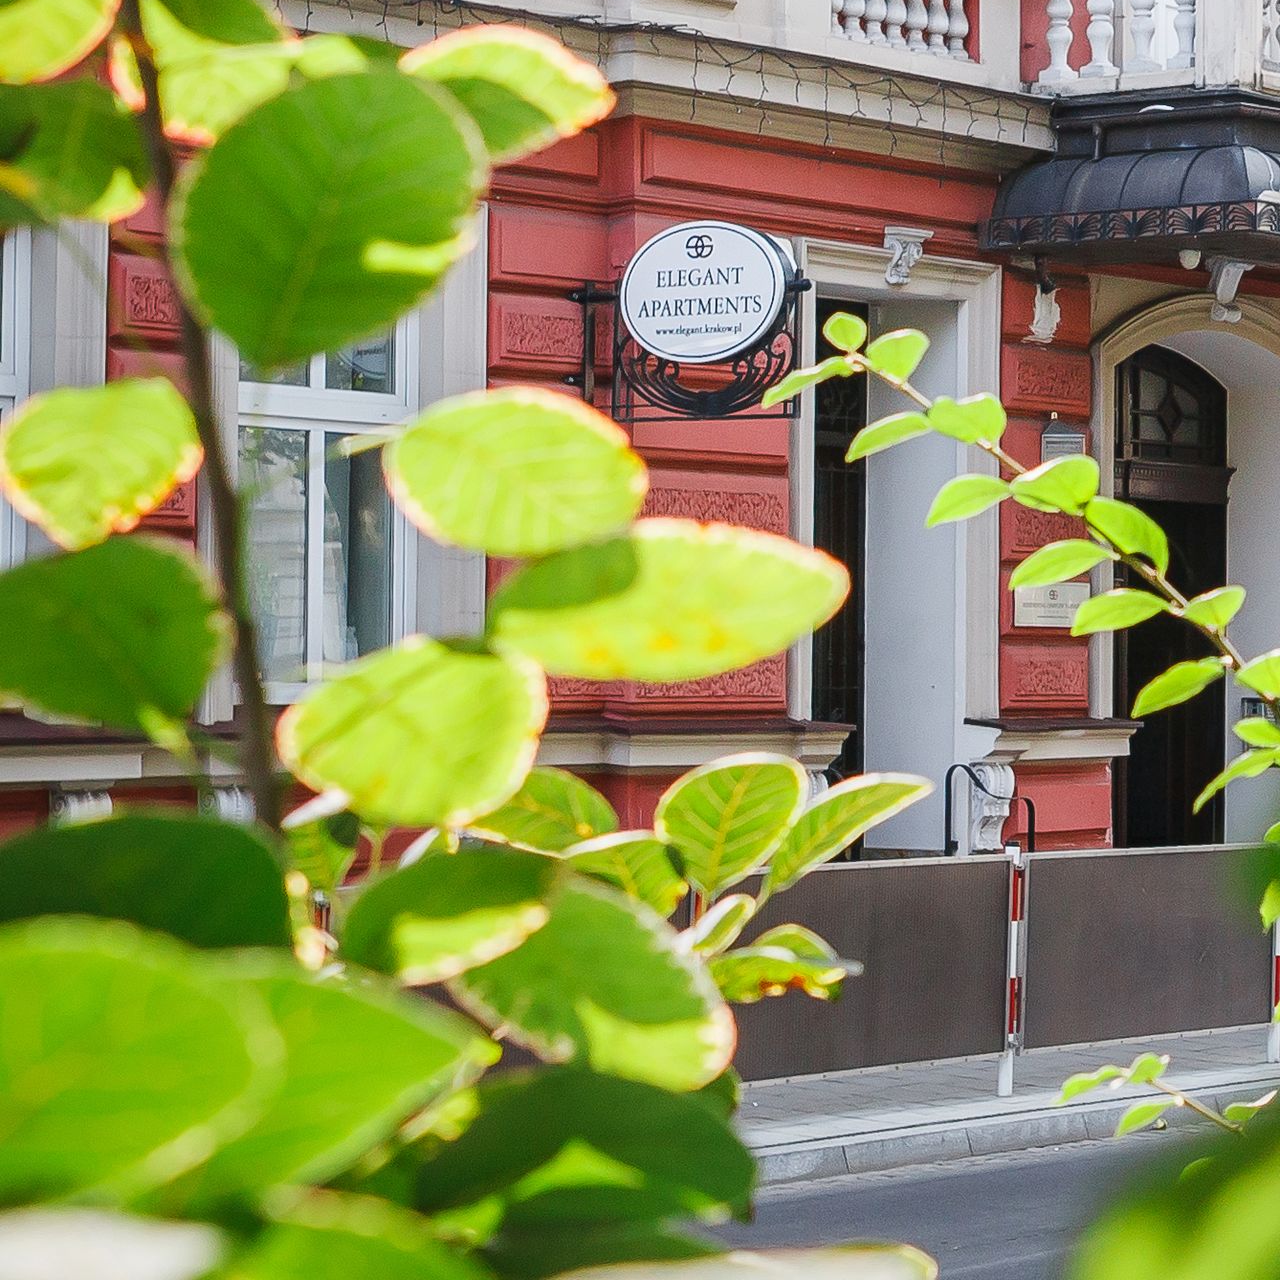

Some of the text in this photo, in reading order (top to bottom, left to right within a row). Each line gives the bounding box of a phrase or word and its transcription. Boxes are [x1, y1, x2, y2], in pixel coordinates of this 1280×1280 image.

[656, 267, 743, 288] ELEGANT
[638, 295, 762, 318] APARTMENTS
[656, 322, 742, 336] www.elegant.krakow.pl
